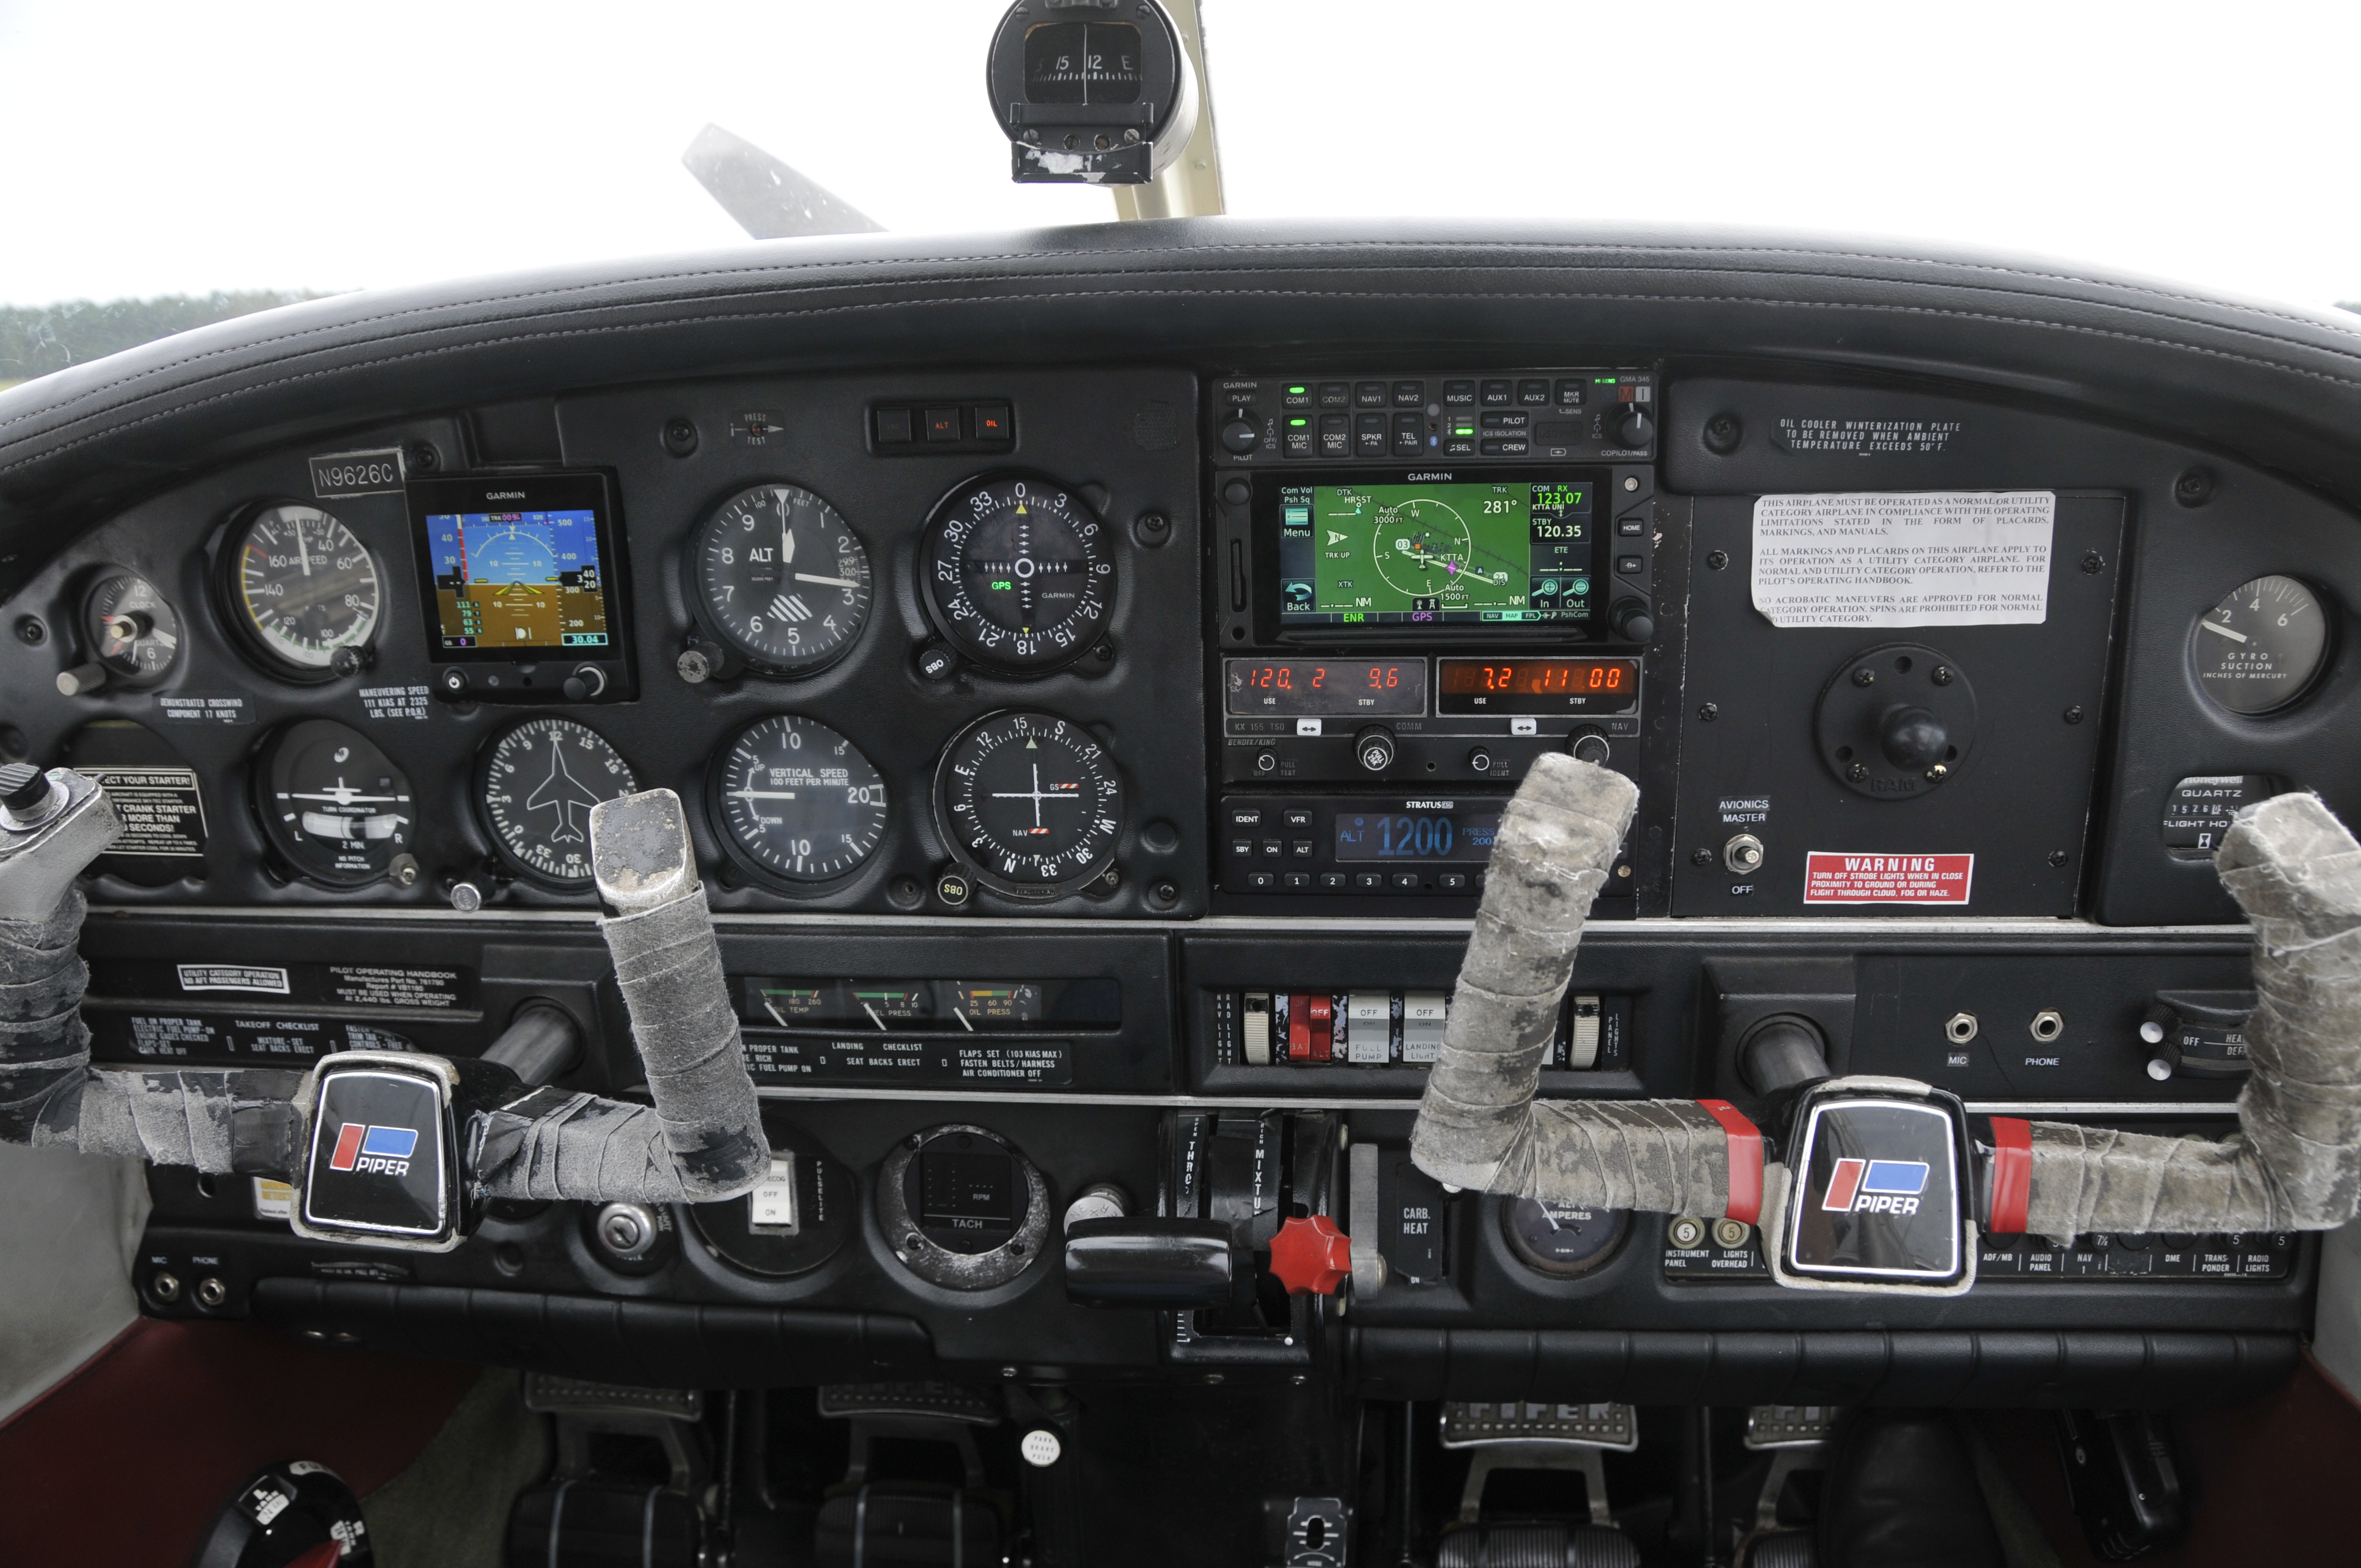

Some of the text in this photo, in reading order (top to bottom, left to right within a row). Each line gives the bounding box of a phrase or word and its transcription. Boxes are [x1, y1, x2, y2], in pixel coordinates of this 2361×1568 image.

[1056, 55, 1133, 70] 15 12 E
[744, 413, 766, 422] PRESS
[1780, 419, 1961, 431] OIL COOLER WINTERIZATION PLATE
[1787, 429, 1797, 438] TO
[1803, 430, 1813, 439] BE
[1820, 431, 1864, 439] REMOVED
[1907, 433, 1949, 441] AMBIENT
[319, 464, 393, 487] N9626C
[486, 492, 525, 500] GARMIN
[970, 491, 992, 511] 33
[1537, 493, 1581, 504] 123.07
[1483, 500, 1517, 513] 281°
[1537, 526, 1581, 537] 120.35
[722, 547, 734, 564] 8
[749, 548, 773, 562] ALT
[269, 556, 287, 567] 160
[337, 558, 352, 569] 60
[938, 560, 953, 581] 27
[265, 584, 283, 596] 140
[991, 581, 1011, 590] GPS
[1084, 600, 1102, 619] 12
[1287, 602, 1310, 611] Back
[1343, 613, 1364, 622] ENR
[1412, 613, 1433, 621] GPS
[750, 616, 763, 632] 6
[788, 628, 799, 644] 5
[926, 659, 943, 673] OBS
[359, 686, 429, 697] MANEUVERING SPEED
[364, 696, 428, 707] 111 KIAS AT 2325
[782, 733, 801, 749] 10
[1367, 754, 1378, 766] 25K
[1372, 749, 1384, 764] PULL
[770, 769, 848, 777] VERTICAL SPEED
[848, 787, 869, 803] 20
[1720, 800, 1769, 809] AVIONICS
[1723, 813, 1765, 822] MASTER
[1377, 817, 1452, 856] 1200
[1845, 858, 1935, 872] WARNING
[1880, 872, 1905, 880] LIGHTS
[944, 884, 962, 895] OBS
[1732, 885, 1753, 894] OFF
[2184, 1037, 2200, 1046] OFF
[1949, 1055, 1967, 1065] MIC
[2025, 1058, 2059, 1066] PHONE
[356, 1157, 409, 1176] PIPER
[1854, 1195, 1919, 1215] PIPER
[1403, 1207, 1430, 1219] CARB.
[952, 1219, 983, 1229] TACH
[1403, 1223, 1428, 1234] HEAT
[1983, 1253, 2012, 1261] ADF/MB
[2245, 1264, 2270, 1272] LIGHTS
